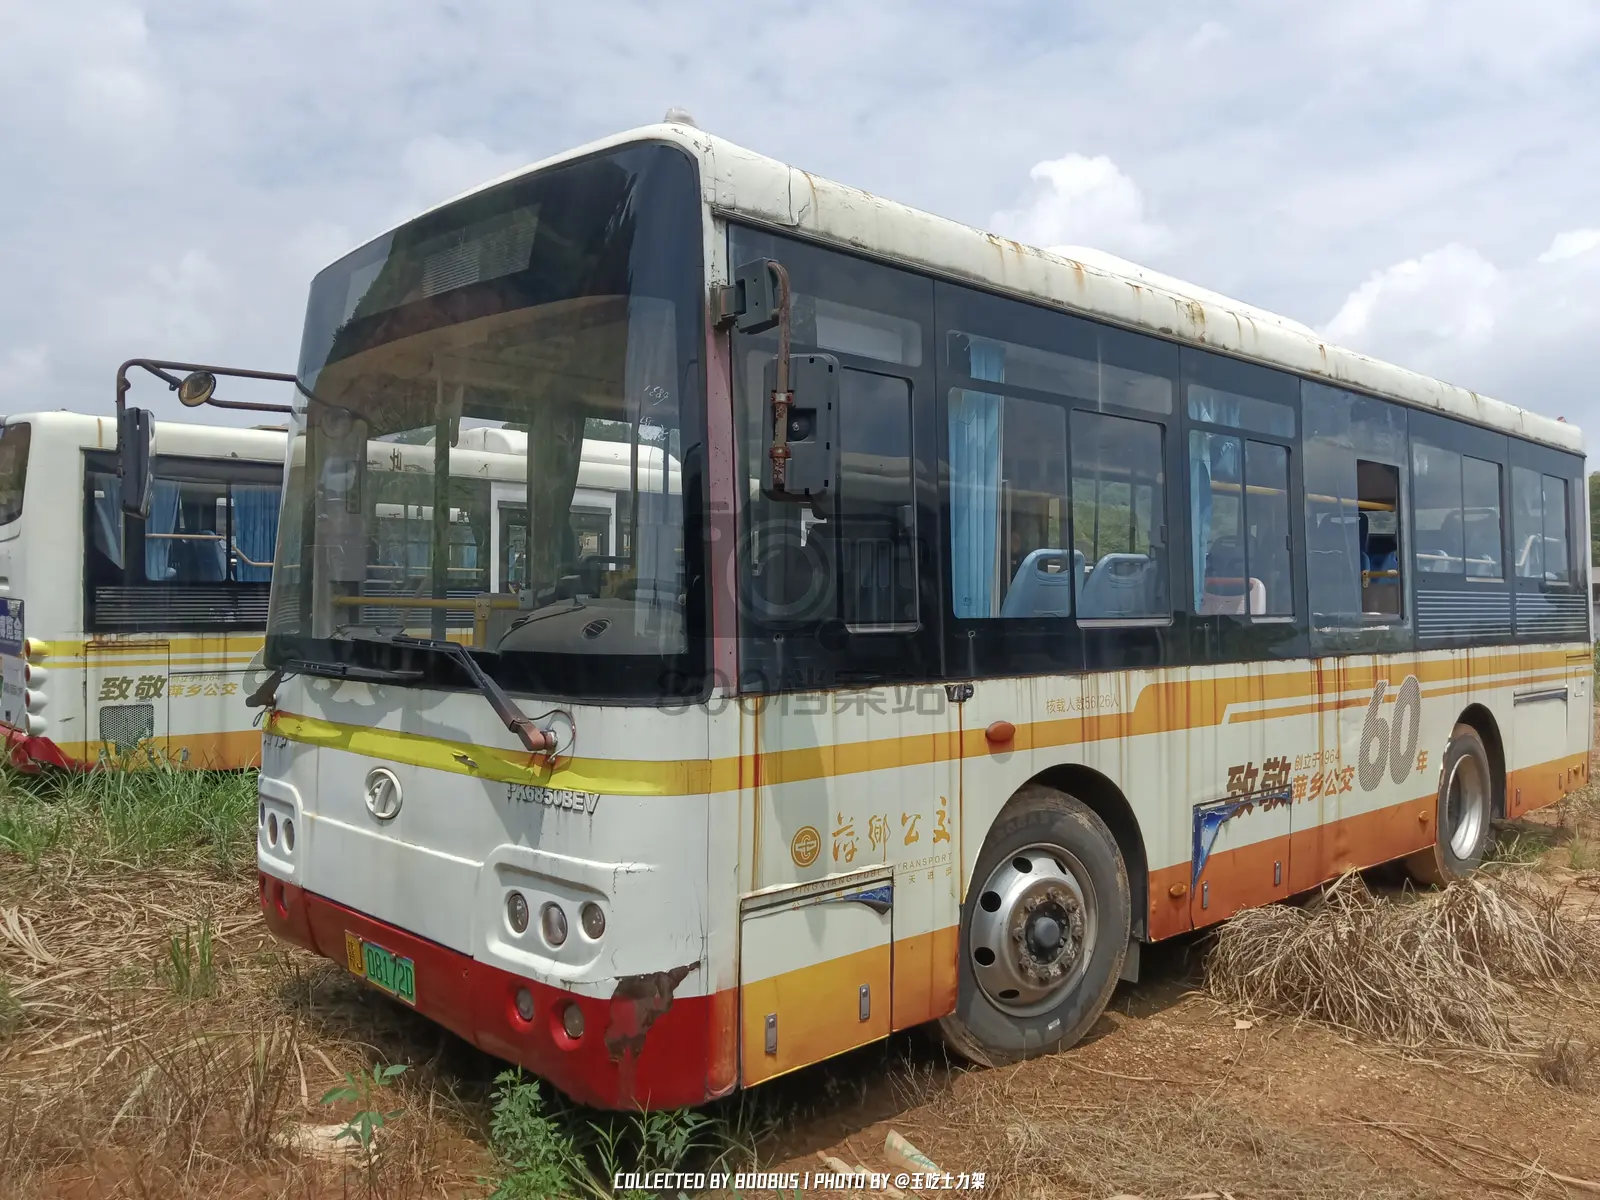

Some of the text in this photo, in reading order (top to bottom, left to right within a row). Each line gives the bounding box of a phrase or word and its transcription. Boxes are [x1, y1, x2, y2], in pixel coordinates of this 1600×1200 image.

[98, 675, 238, 701] 致敬 萍乡公交
[1224, 674, 1429, 818] 致敬 萍乡公交 60 年
[1294, 749, 1341, 771] 创立于1964
[856, 867, 892, 880] PUBLC
